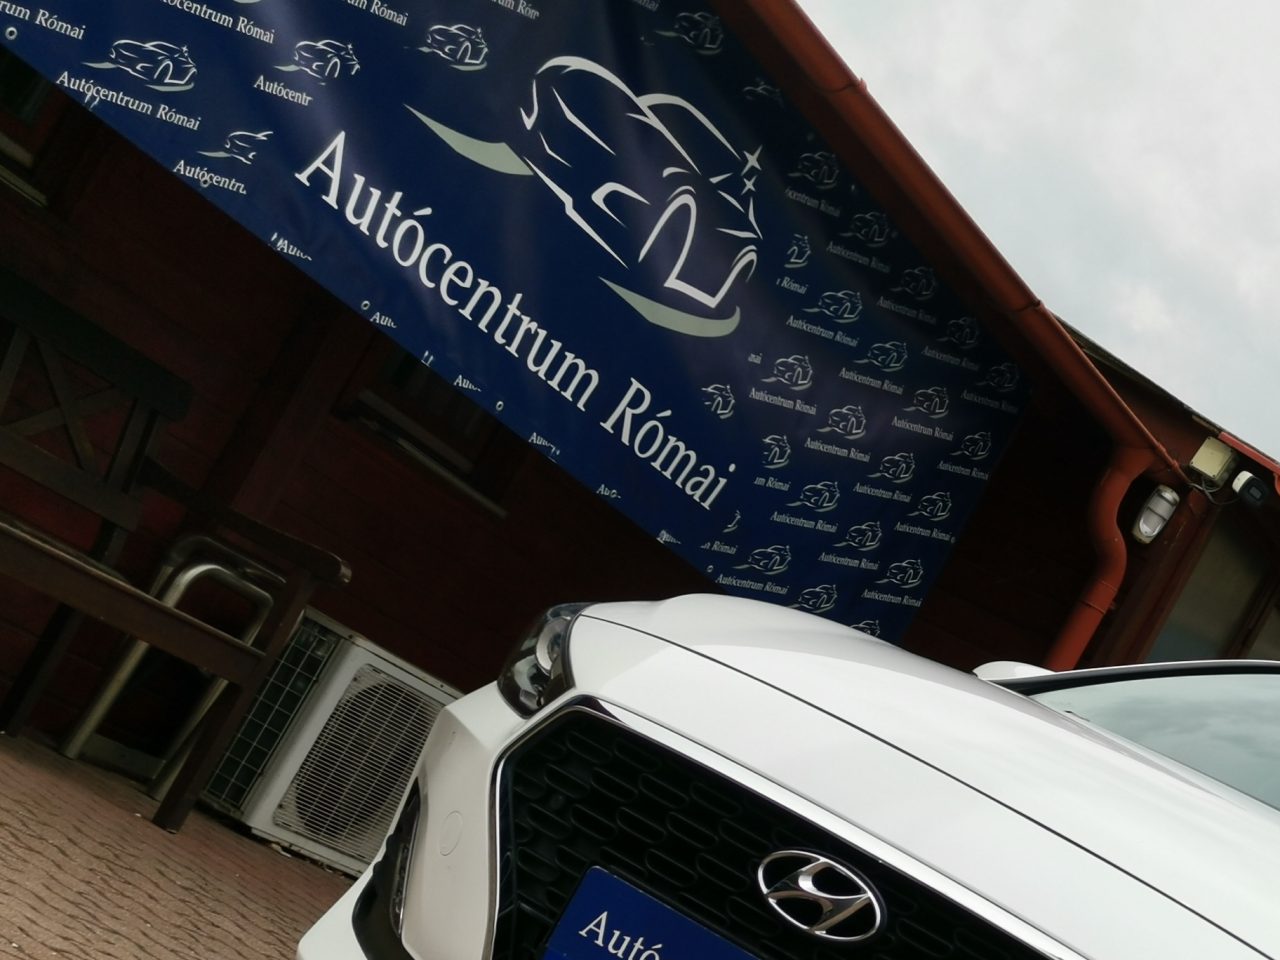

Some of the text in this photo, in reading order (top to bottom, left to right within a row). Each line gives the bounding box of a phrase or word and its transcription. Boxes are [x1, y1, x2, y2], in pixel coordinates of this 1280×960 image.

[35, 8, 87, 40] Római
[236, 16, 275, 44] Római
[56, 71, 202, 131] Autócentrum Római
[781, 276, 809, 295] Római
[295, 130, 737, 511] Autócentrum Római
[786, 315, 860, 348] Autócentrum Római
[839, 367, 882, 389] Autócentrum
[749, 388, 817, 415] Autócentrum Római
[804, 437, 871, 463] Autócentrum Római
[766, 476, 791, 492] Római
[770, 511, 839, 534] Autócentrum Római
[818, 552, 860, 568] Autócentrum
[715, 573, 790, 596] Autócentrum Római
